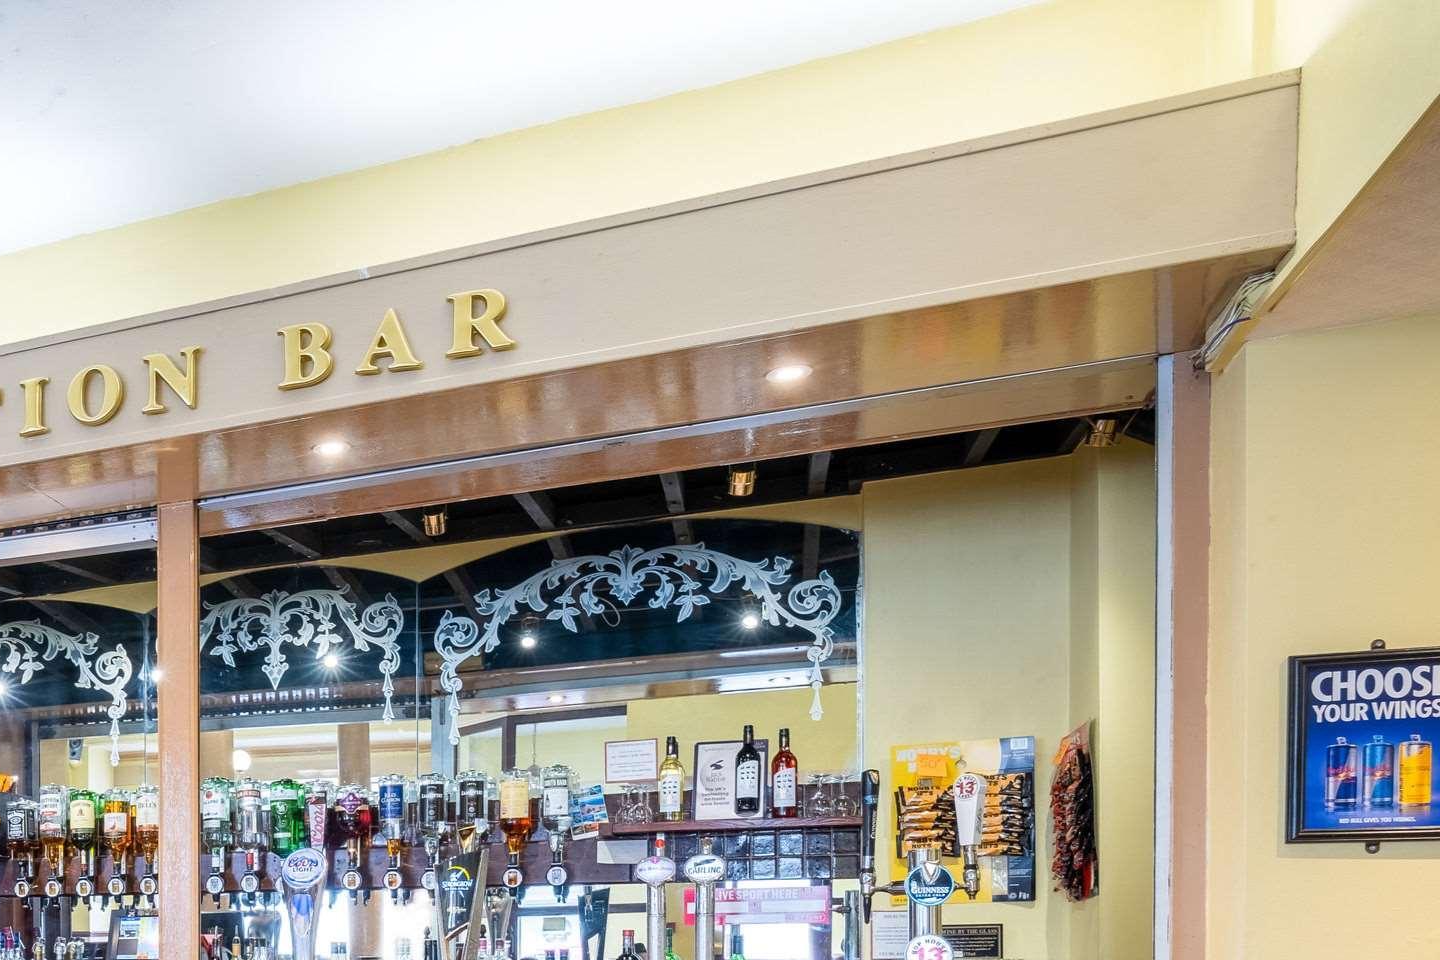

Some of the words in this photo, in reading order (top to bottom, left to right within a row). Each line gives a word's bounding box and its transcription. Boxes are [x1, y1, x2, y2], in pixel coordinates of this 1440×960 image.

[276, 287, 517, 392] BAR
[1312, 701, 1369, 724] YOUR
[1371, 699, 1440, 720] WINGS
[955, 780, 975, 795] 13
[287, 856, 319, 867] Coors
[687, 865, 722, 876] CARLING
[714, 891, 737, 901] IVE
[737, 890, 770, 900] SPORT
[772, 888, 798, 899] HERE
[911, 884, 949, 895] GUINNESS
